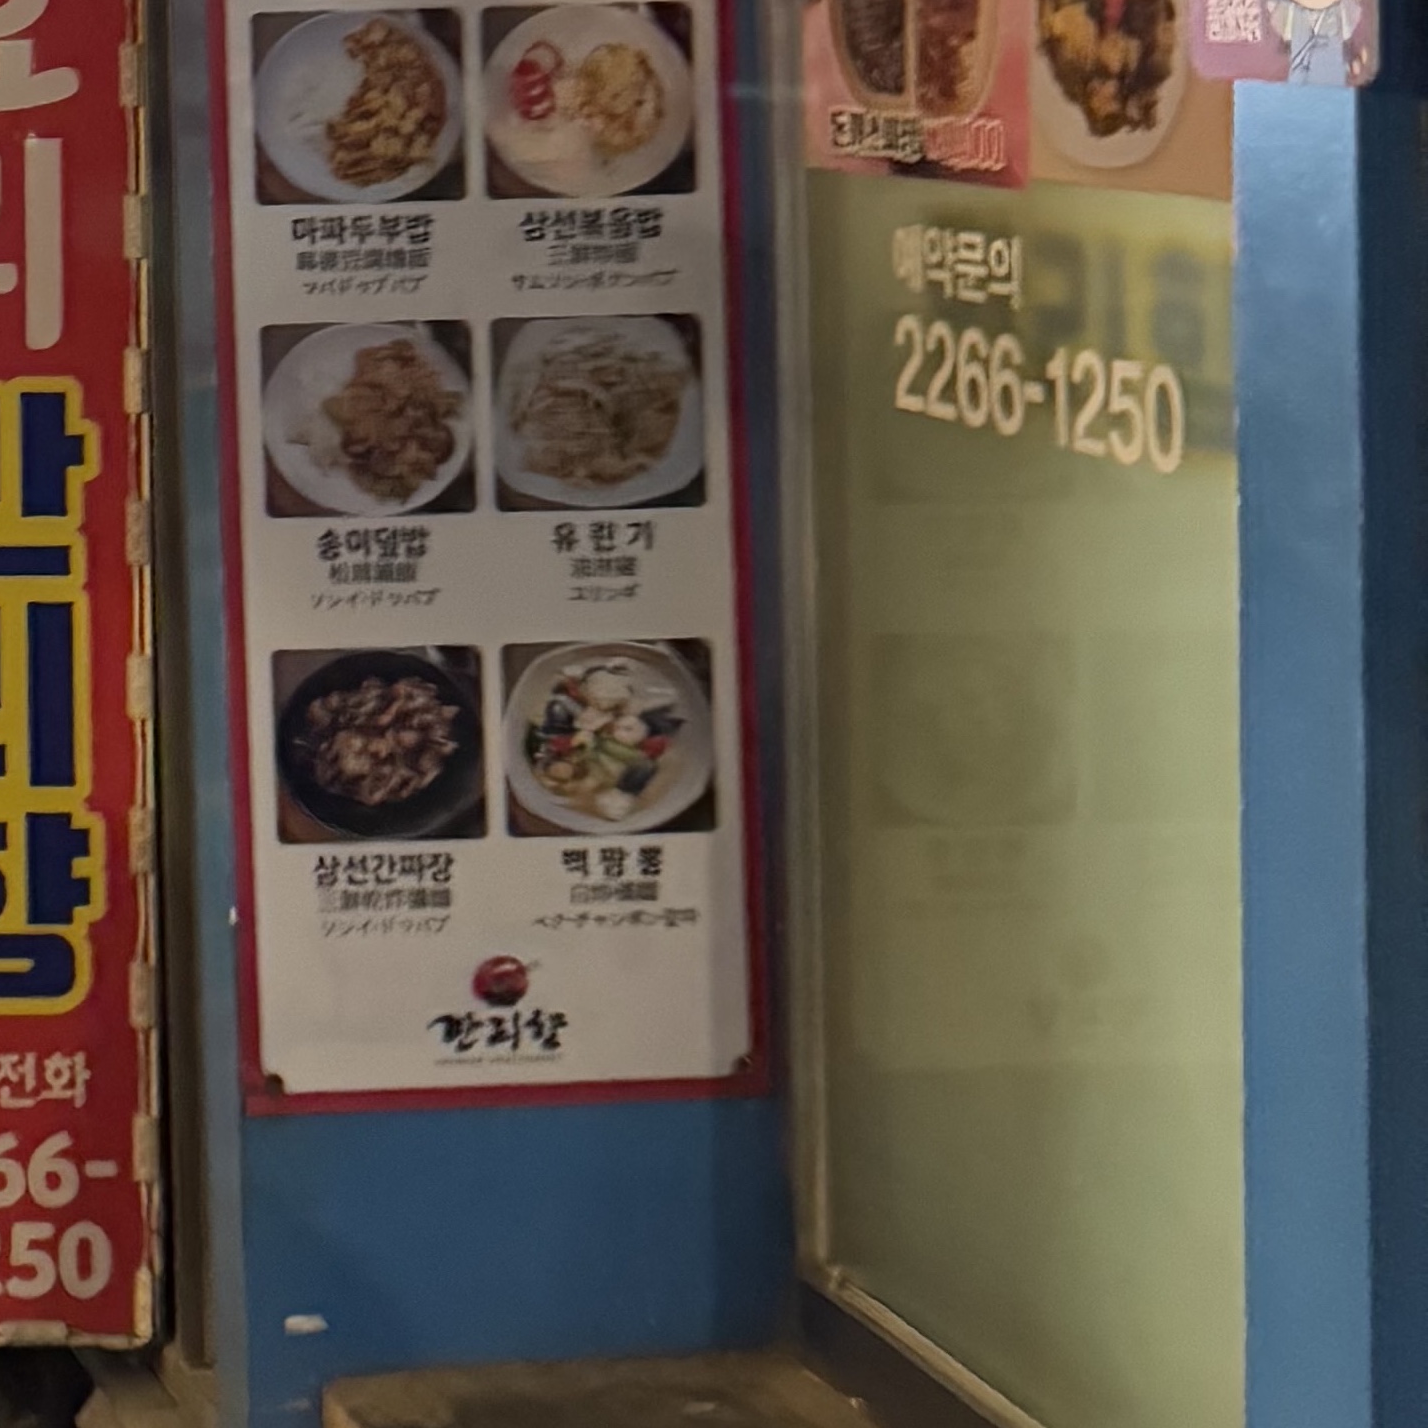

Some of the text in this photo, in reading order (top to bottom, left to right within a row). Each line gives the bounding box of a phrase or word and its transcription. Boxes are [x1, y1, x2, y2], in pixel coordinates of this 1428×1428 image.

[292, 214, 436, 245] 마파두부밥
[518, 207, 664, 242] 삼선볶음밥
[894, 313, 1185, 474] 2266-1250
[317, 527, 431, 561] 송이덮밥
[551, 521, 654, 553] 유린기
[560, 844, 664, 878] 백짬뽕
